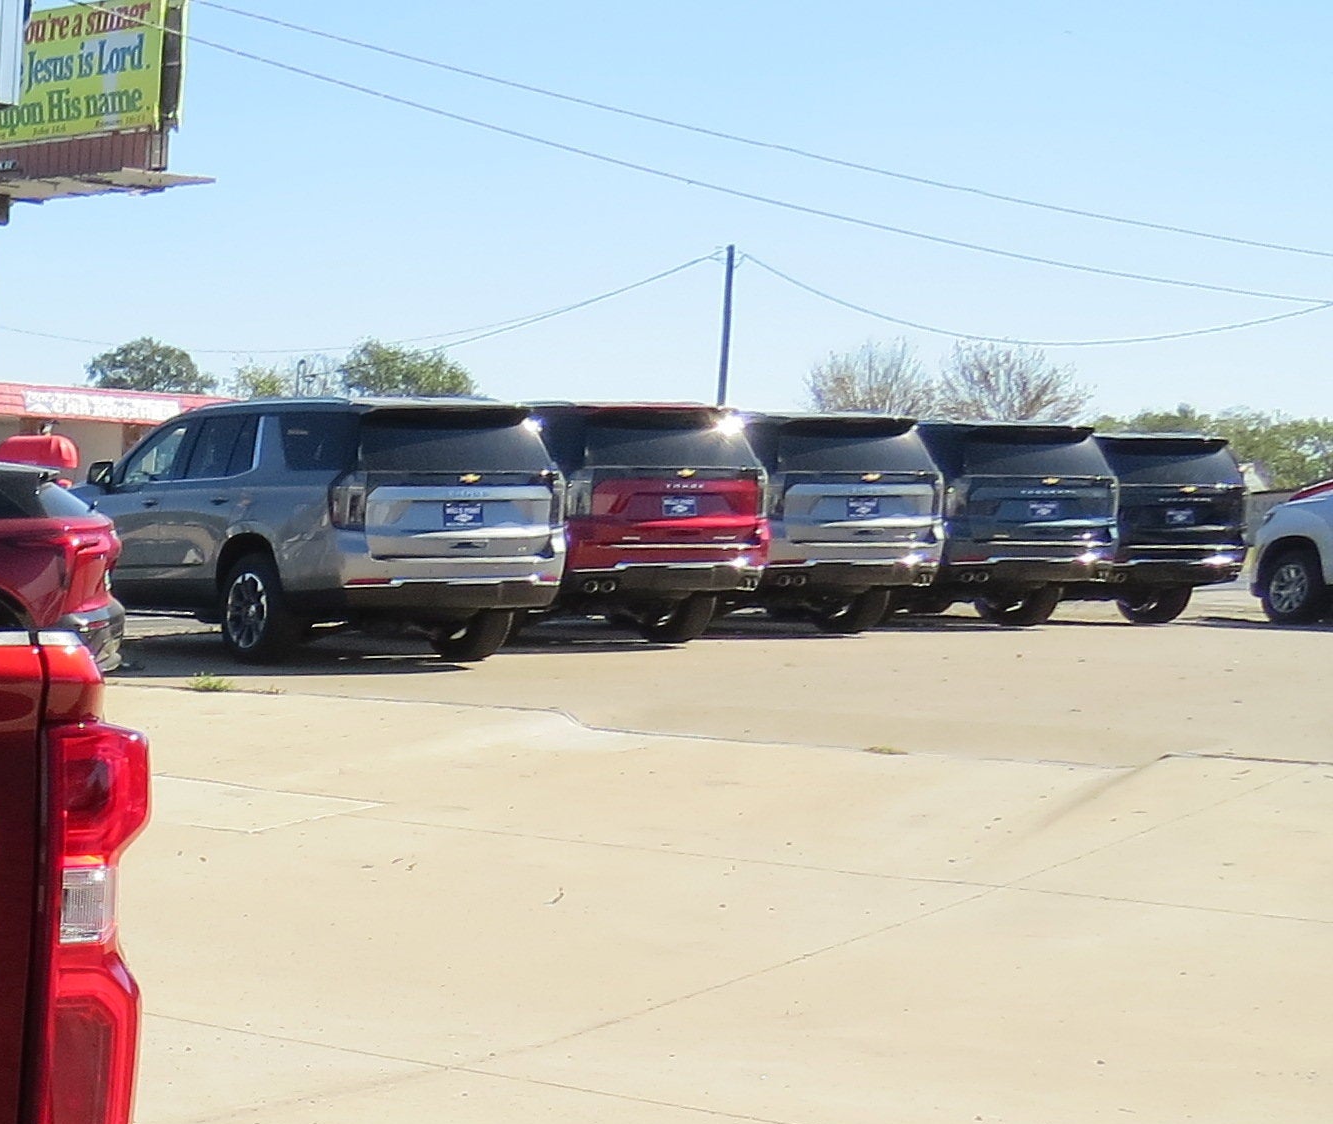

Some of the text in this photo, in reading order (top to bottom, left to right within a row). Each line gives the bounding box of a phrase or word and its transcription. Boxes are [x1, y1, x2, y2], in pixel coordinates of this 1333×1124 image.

[25, 13, 70, 44] ou're
[71, 15, 83, 37] a
[26, 50, 74, 94] Jesus
[77, 41, 94, 79] is
[46, 88, 82, 123] His
